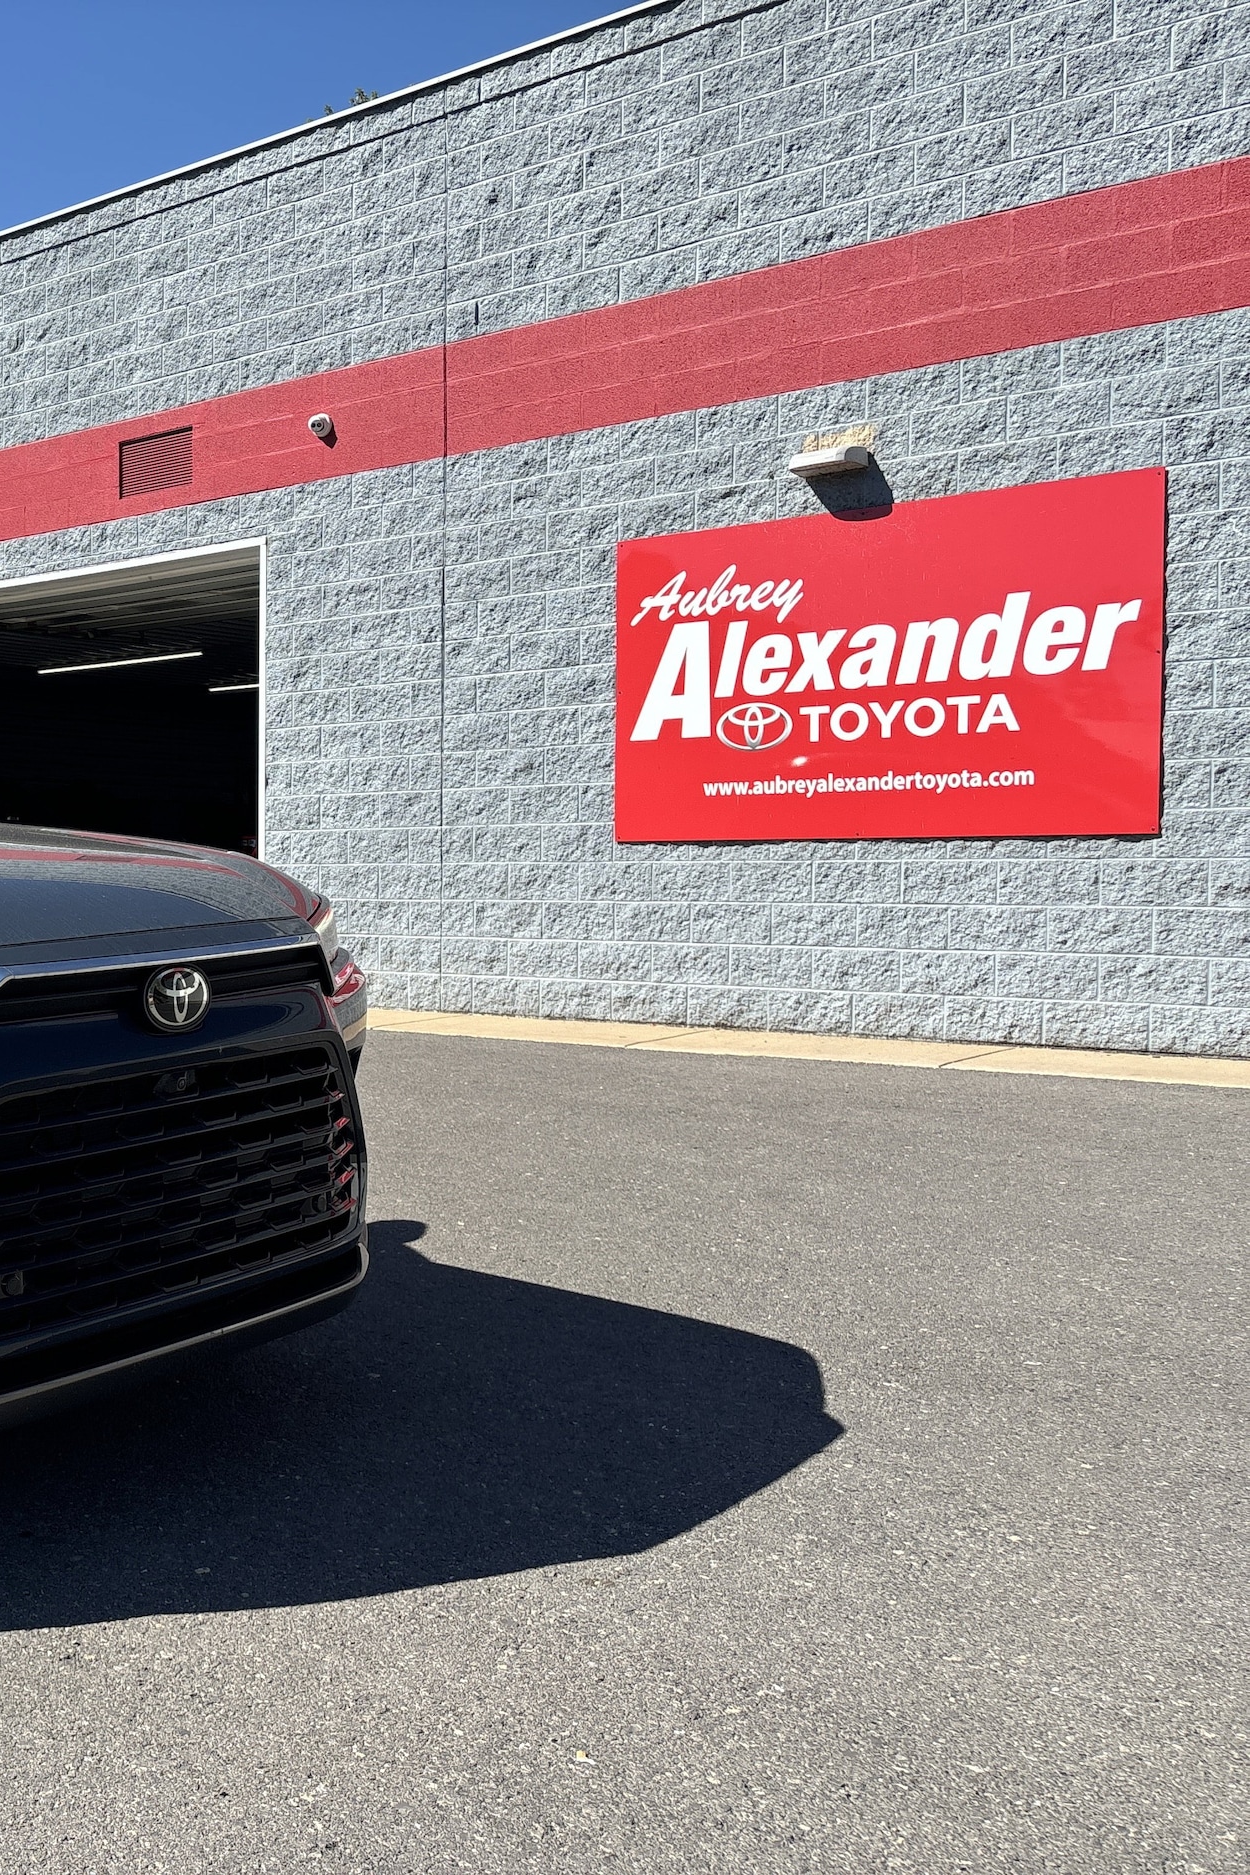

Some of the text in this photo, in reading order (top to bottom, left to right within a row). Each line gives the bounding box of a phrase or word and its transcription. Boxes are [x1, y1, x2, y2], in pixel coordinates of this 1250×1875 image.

[630, 563, 804, 627] Aubrey
[629, 591, 1143, 742] Alexander
[799, 693, 1021, 743] TOYOTA
[702, 769, 1035, 799] www.aubreyalexandertoyota.com
